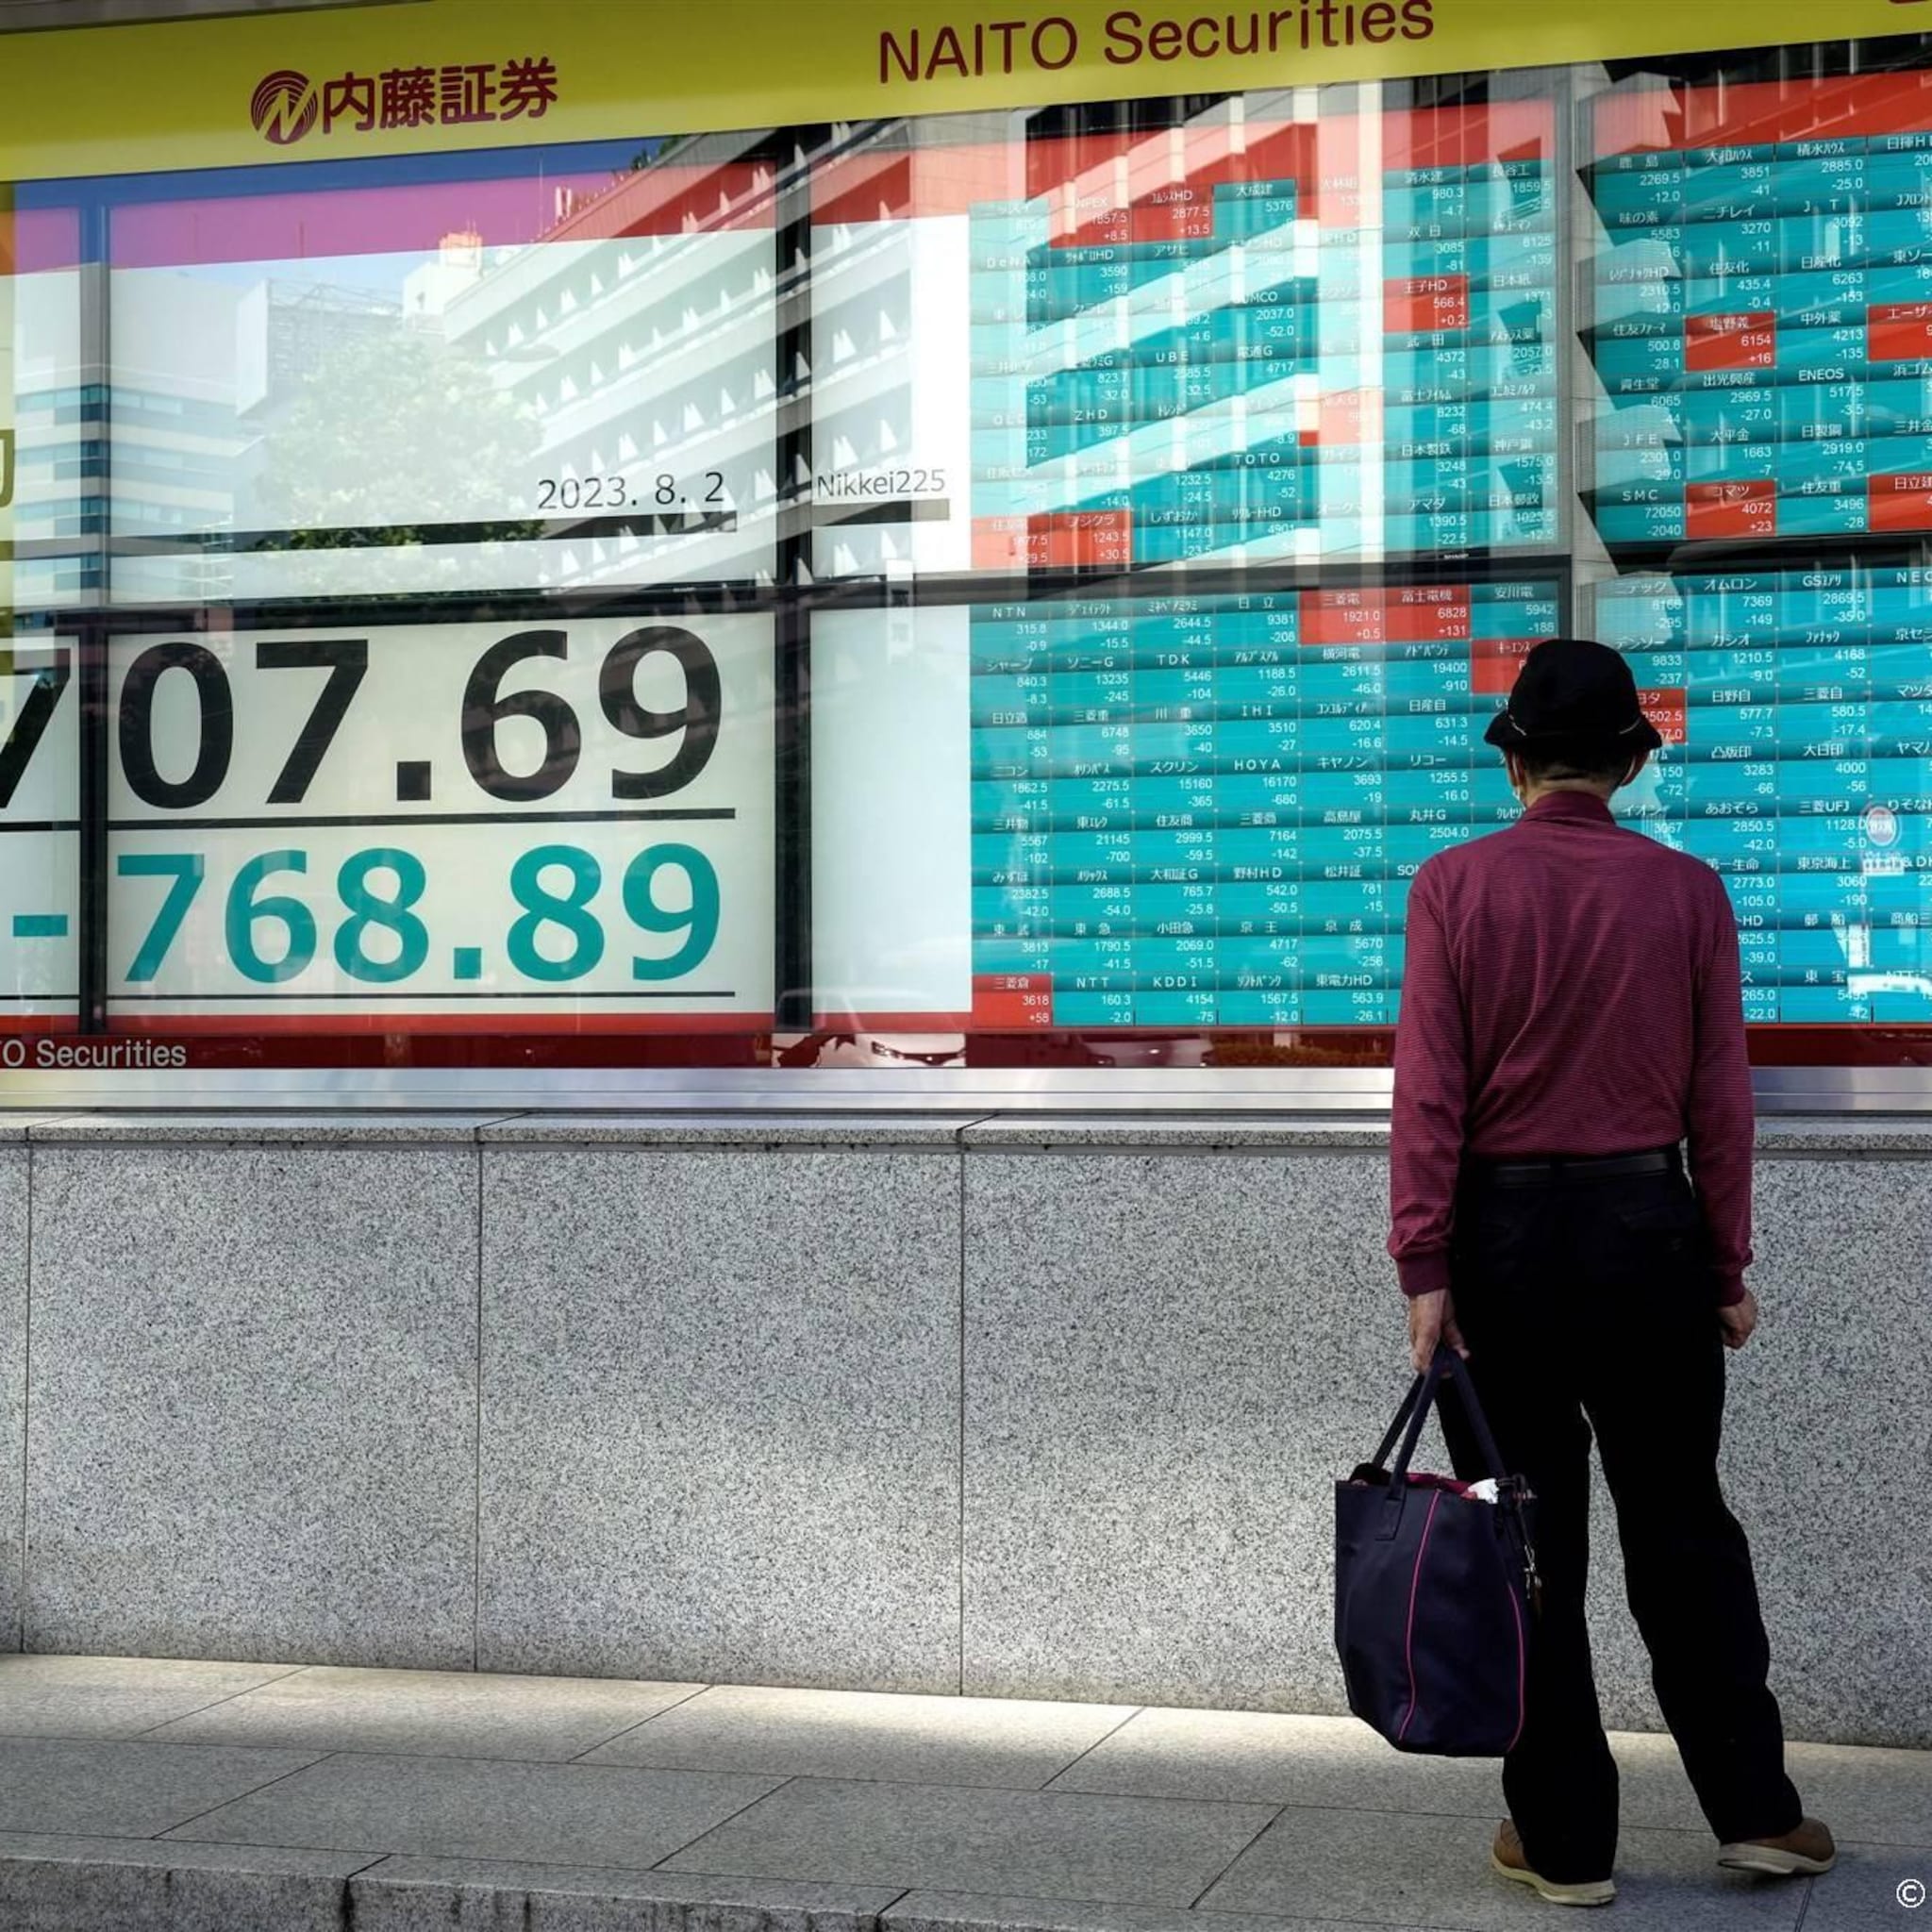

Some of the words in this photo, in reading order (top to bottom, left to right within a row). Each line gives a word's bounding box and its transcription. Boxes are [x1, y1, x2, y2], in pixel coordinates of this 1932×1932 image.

[879, 16, 1078, 84] NAITO
[1104, 0, 1434, 65] Securities
[322, 56, 558, 134] 内藤証券
[1740, 166, 1770, 178] 3851
[1822, 159, 1863, 173] 2885.0
[1832, 178, 1863, 190] -25.0
[1741, 223, 1772, 235] 3270
[1751, 242, 1771, 253] -11
[1738, 278, 1772, 291] 435.4
[1832, 273, 1863, 286] 6263
[1747, 297, 1772, 308] -0.4
[1256, 308, 1294, 321] 2037.0
[1440, 315, 1465, 326] +0.2
[1265, 326, 1294, 338] -52.0
[1832, 329, 1863, 341] 4213
[1741, 335, 1772, 347] 6154
[1748, 353, 1772, 364] +16
[1836, 347, 1863, 359] -135
[1799, 368, 1844, 381] ENEOS
[1730, 391, 1773, 404] 2969.5
[1074, 409, 1108, 421] ZHD
[1740, 409, 1773, 421] -27.0
[1743, 446, 1773, 458] 1663
[1822, 442, 1864, 456] 2919.0
[1235, 453, 1280, 465] TOTO
[817, 468, 946, 499] Nikkei225
[1623, 489, 1658, 502] SMC
[1741, 502, 1773, 515] 4072
[1834, 498, 1864, 511] 3496
[1645, 507, 1681, 519] 72050
[1750, 521, 1773, 534] +23
[1844, 517, 1864, 530] -28
[1646, 525, 1681, 537] -2040
[1705, 579, 1757, 591] オムロン
[1743, 594, 1773, 607] 7369
[992, 607, 1025, 618] NTN
[1438, 608, 1467, 618] 6828
[1174, 617, 1211, 628] 2644.5
[1266, 614, 1295, 625] 9381
[1744, 613, 1773, 625] -149
[1438, 625, 1467, 637] +131
[1100, 638, 1128, 648] -15.5
[1158, 654, 1190, 665] TDK
[1652, 654, 1682, 667] 9833
[1733, 651, 1773, 664] 1210.5
[1257, 667, 1296, 678] 1188.5
[1432, 662, 1468, 674] 19400
[1845, 667, 1865, 679] -52
[1095, 674, 1129, 685] 13235
[1184, 671, 1211, 681] 5446
[1749, 670, 1773, 682] -9.0
[1267, 686, 1296, 696] -26.0
[1441, 679, 1468, 691] -910
[1105, 691, 1129, 702] -245
[1187, 688, 1211, 699] -104
[1242, 705, 1272, 716] IHI
[1740, 708, 1774, 721] 577.7
[1831, 705, 1865, 718] 580.5
[1268, 721, 1296, 733] 3510
[1349, 719, 1381, 730] 620.4
[1435, 717, 1468, 729] 631.3
[1750, 726, 1774, 739] -7.3
[1833, 724, 1866, 736] -17.4
[1278, 740, 1296, 751] -27
[1352, 737, 1382, 748] -16.6
[1438, 735, 1468, 746] -14.5
[1193, 741, 1212, 753] -40
[1235, 758, 1280, 770] HOYA
[1409, 756, 1447, 767] リコー
[1835, 761, 1866, 774] 4000
[1743, 764, 1774, 776] 3283
[1754, 783, 1774, 795] -66
[1846, 781, 1866, 793] -56
[1438, 791, 1468, 800] -16.0
[1733, 821, 1774, 832] 2850.5
[1096, 834, 1130, 844] 21145
[1175, 833, 1213, 843] 2999.5
[1270, 830, 1296, 841] 7164
[1343, 829, 1383, 840] 2075.5
[1429, 827, 1469, 839] 2504.0
[1743, 839, 1774, 850] -42.0
[1106, 851, 1130, 862] -700
[1354, 847, 1383, 858] -37.5
[1733, 876, 1774, 888] 2773.0
[1183, 886, 1213, 896] 765.7
[1266, 885, 1298, 895] 542.0
[1364, 901, 1383, 911] -15
[1736, 896, 1774, 907] -105.0
[1185, 904, 1213, 914] -25.8
[1094, 941, 1131, 952] 1790.5
[1270, 939, 1298, 950] 4717
[1280, 957, 1298, 968] -62
[1745, 951, 1775, 962] -39.0
[1031, 958, 1048, 969] -17
[1103, 958, 1131, 969] -41.5
[1076, 977, 1110, 988] NTT
[1153, 976, 1197, 988] KDDI
[1102, 995, 1131, 1006] 160.3
[1261, 993, 1298, 1004] 1567.5
[1109, 1012, 1131, 1024] -2.0
[1195, 1011, 1214, 1023] -75
[1270, 1011, 1298, 1022] -12.0
[1354, 1010, 1383, 1021] -26.1
[0, 1039, 26, 1067] O
[36, 1039, 187, 1067] Securities
